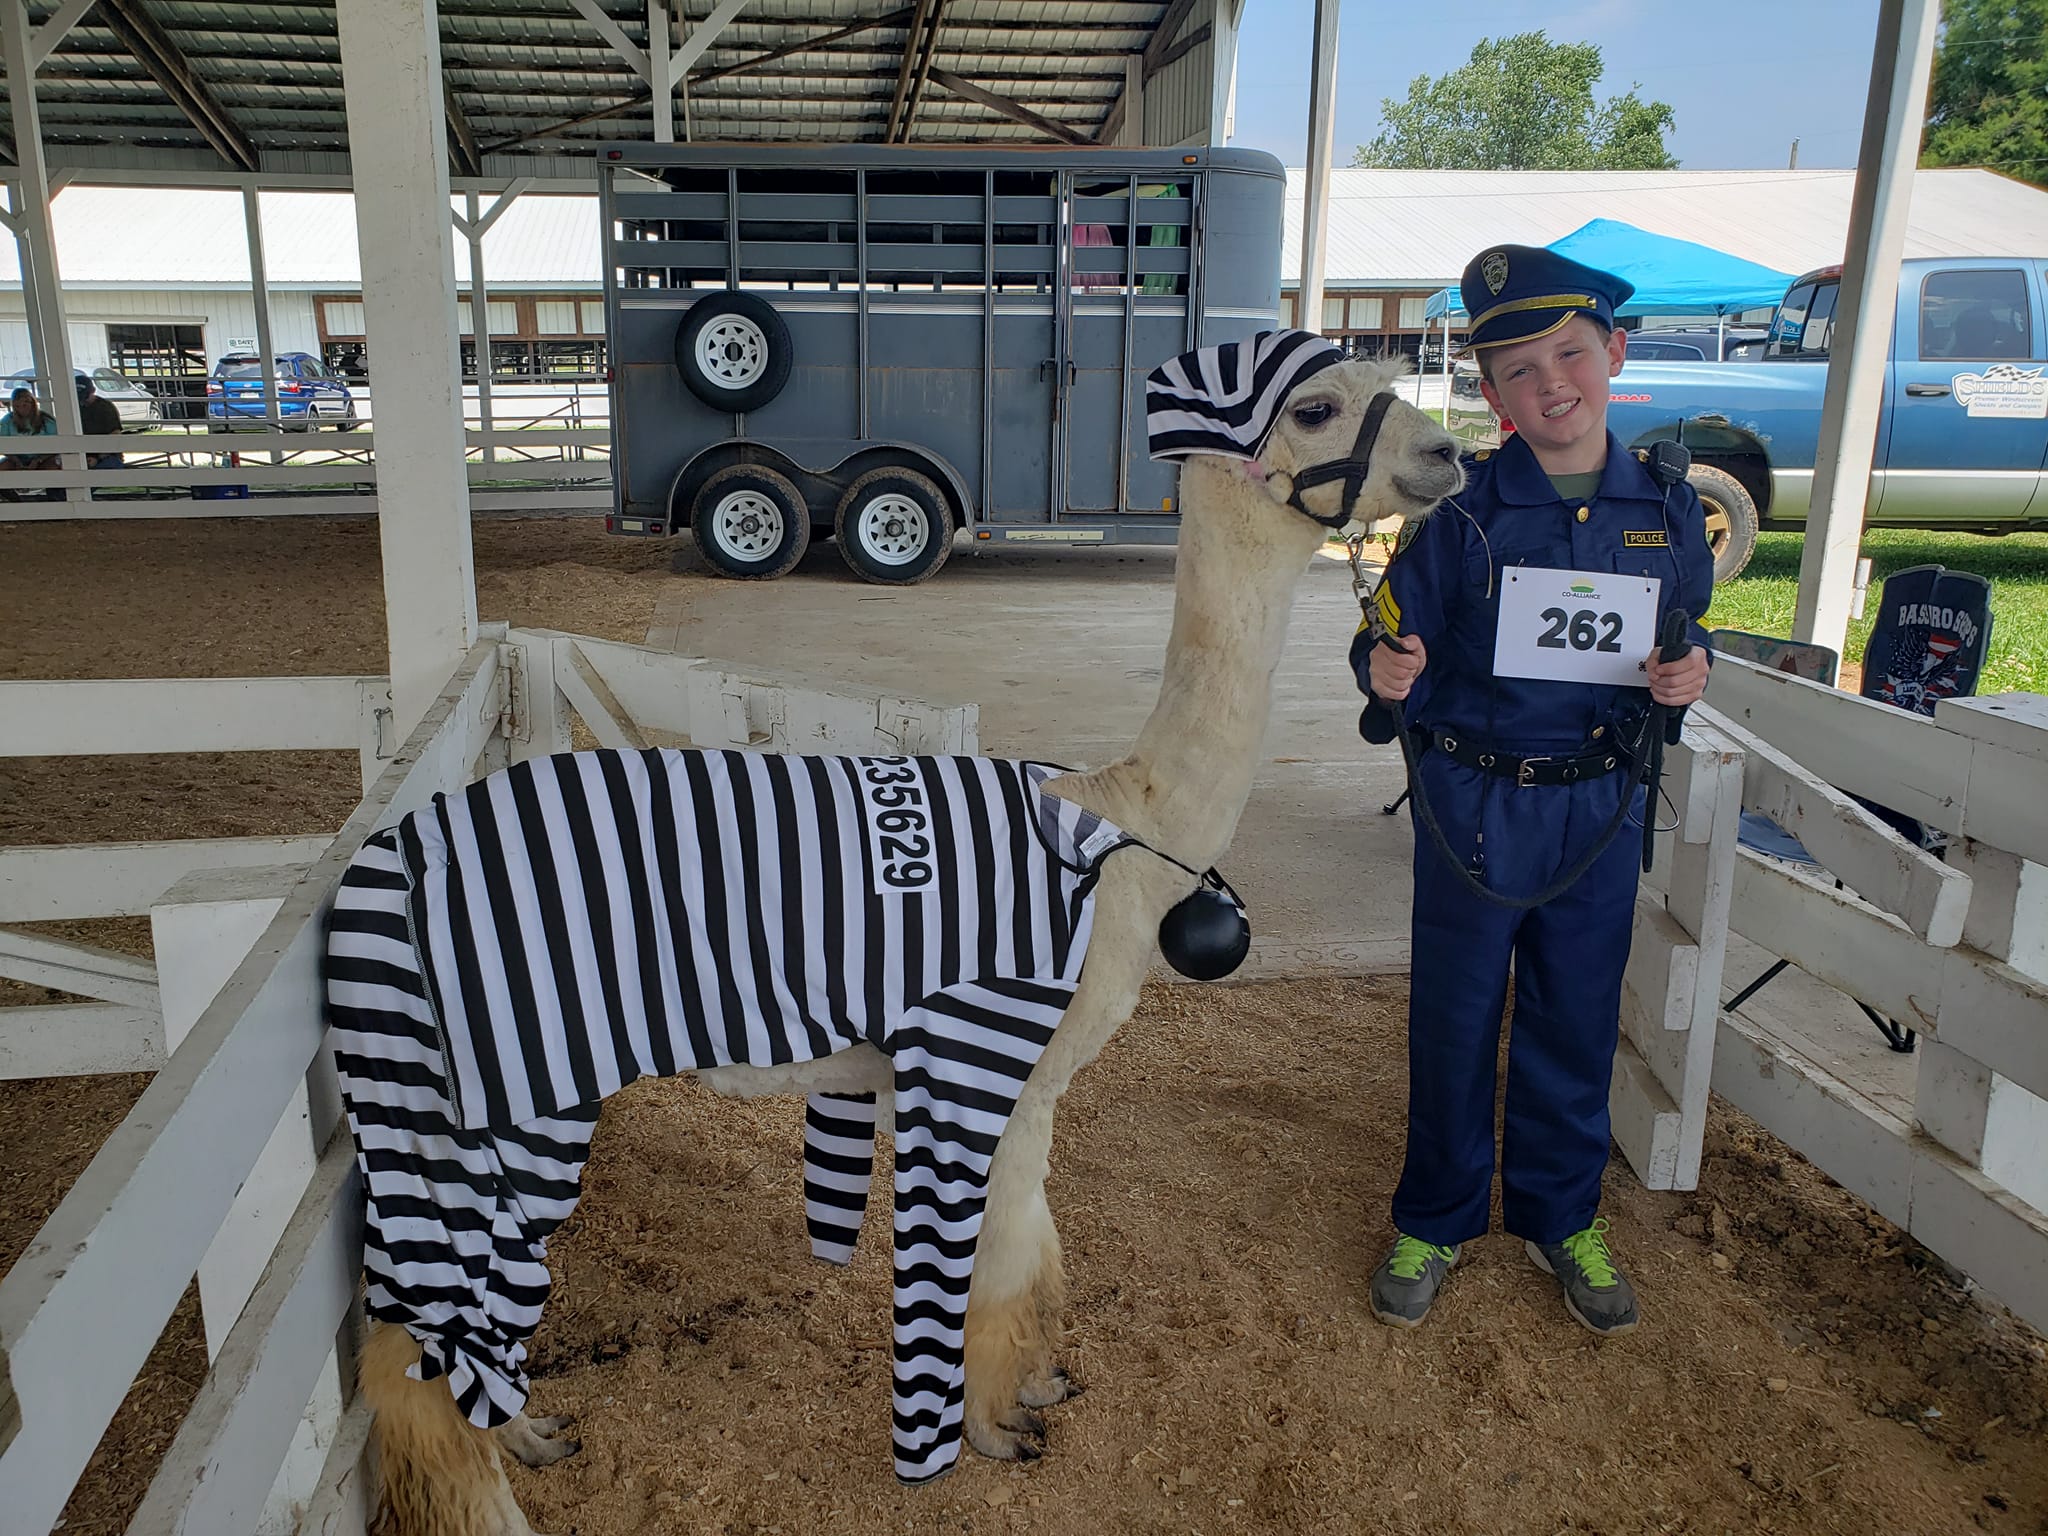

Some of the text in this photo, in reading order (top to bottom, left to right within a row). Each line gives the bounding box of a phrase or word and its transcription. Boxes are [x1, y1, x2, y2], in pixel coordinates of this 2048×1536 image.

[1959, 379, 2045, 396] SHIELDS
[1630, 534, 1665, 543] POLICE
[1561, 591, 1601, 600] CO-ALLIANCE
[1536, 607, 1623, 653] 262
[858, 756, 932, 888] 235629
